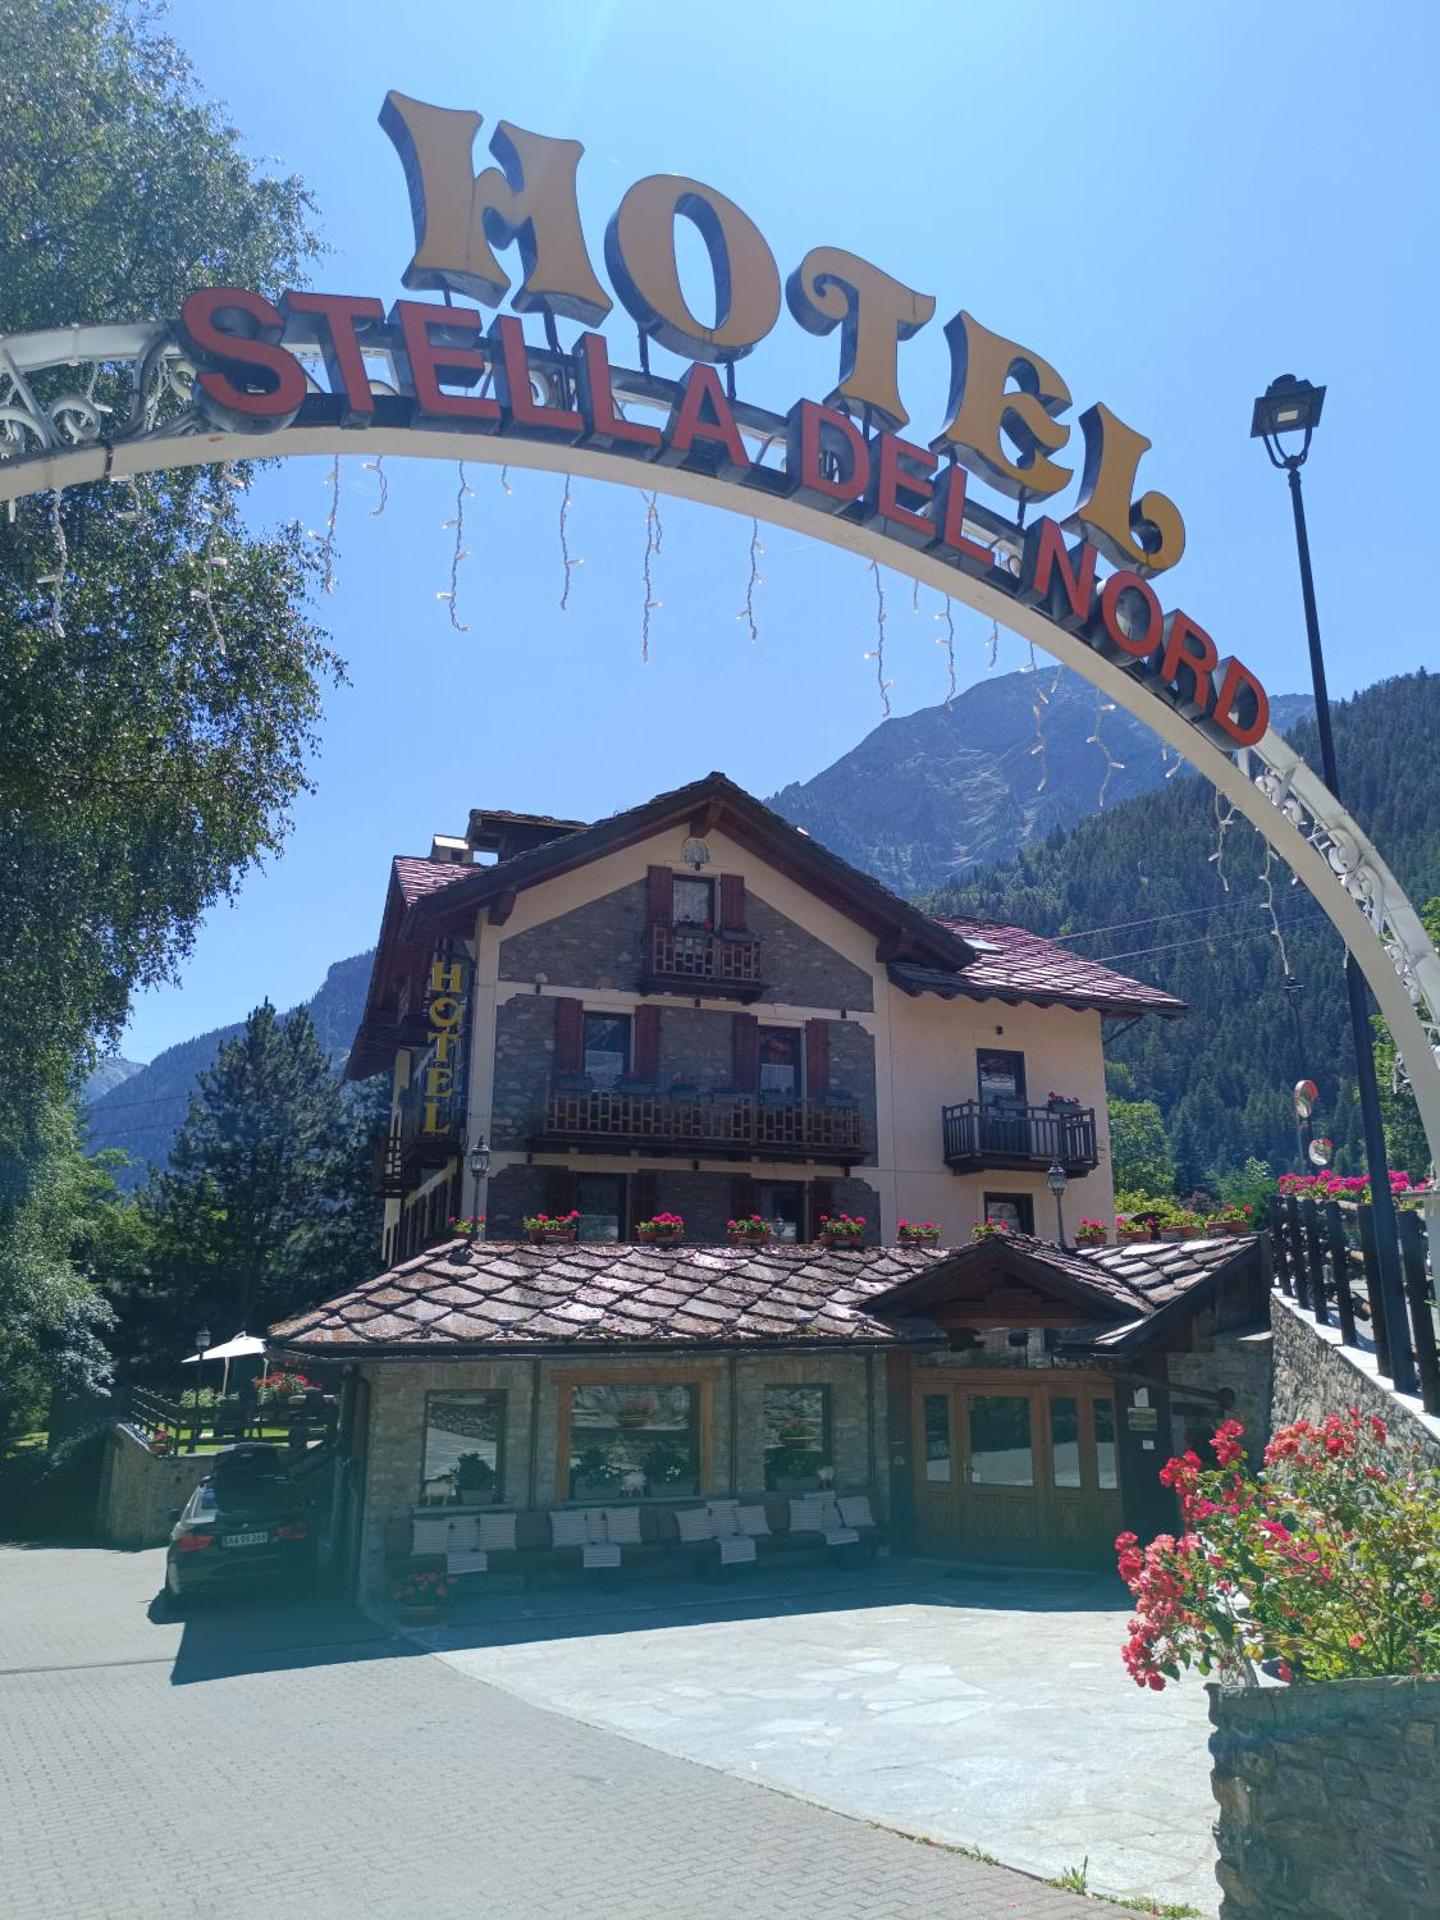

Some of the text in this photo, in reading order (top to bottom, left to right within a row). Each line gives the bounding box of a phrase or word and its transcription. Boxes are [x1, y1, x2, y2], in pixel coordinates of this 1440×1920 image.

[179, 287, 1270, 748] STELLA DEL NORD
[378, 89, 1186, 579] HOTEL
[424, 961, 463, 1135] HOTEL
